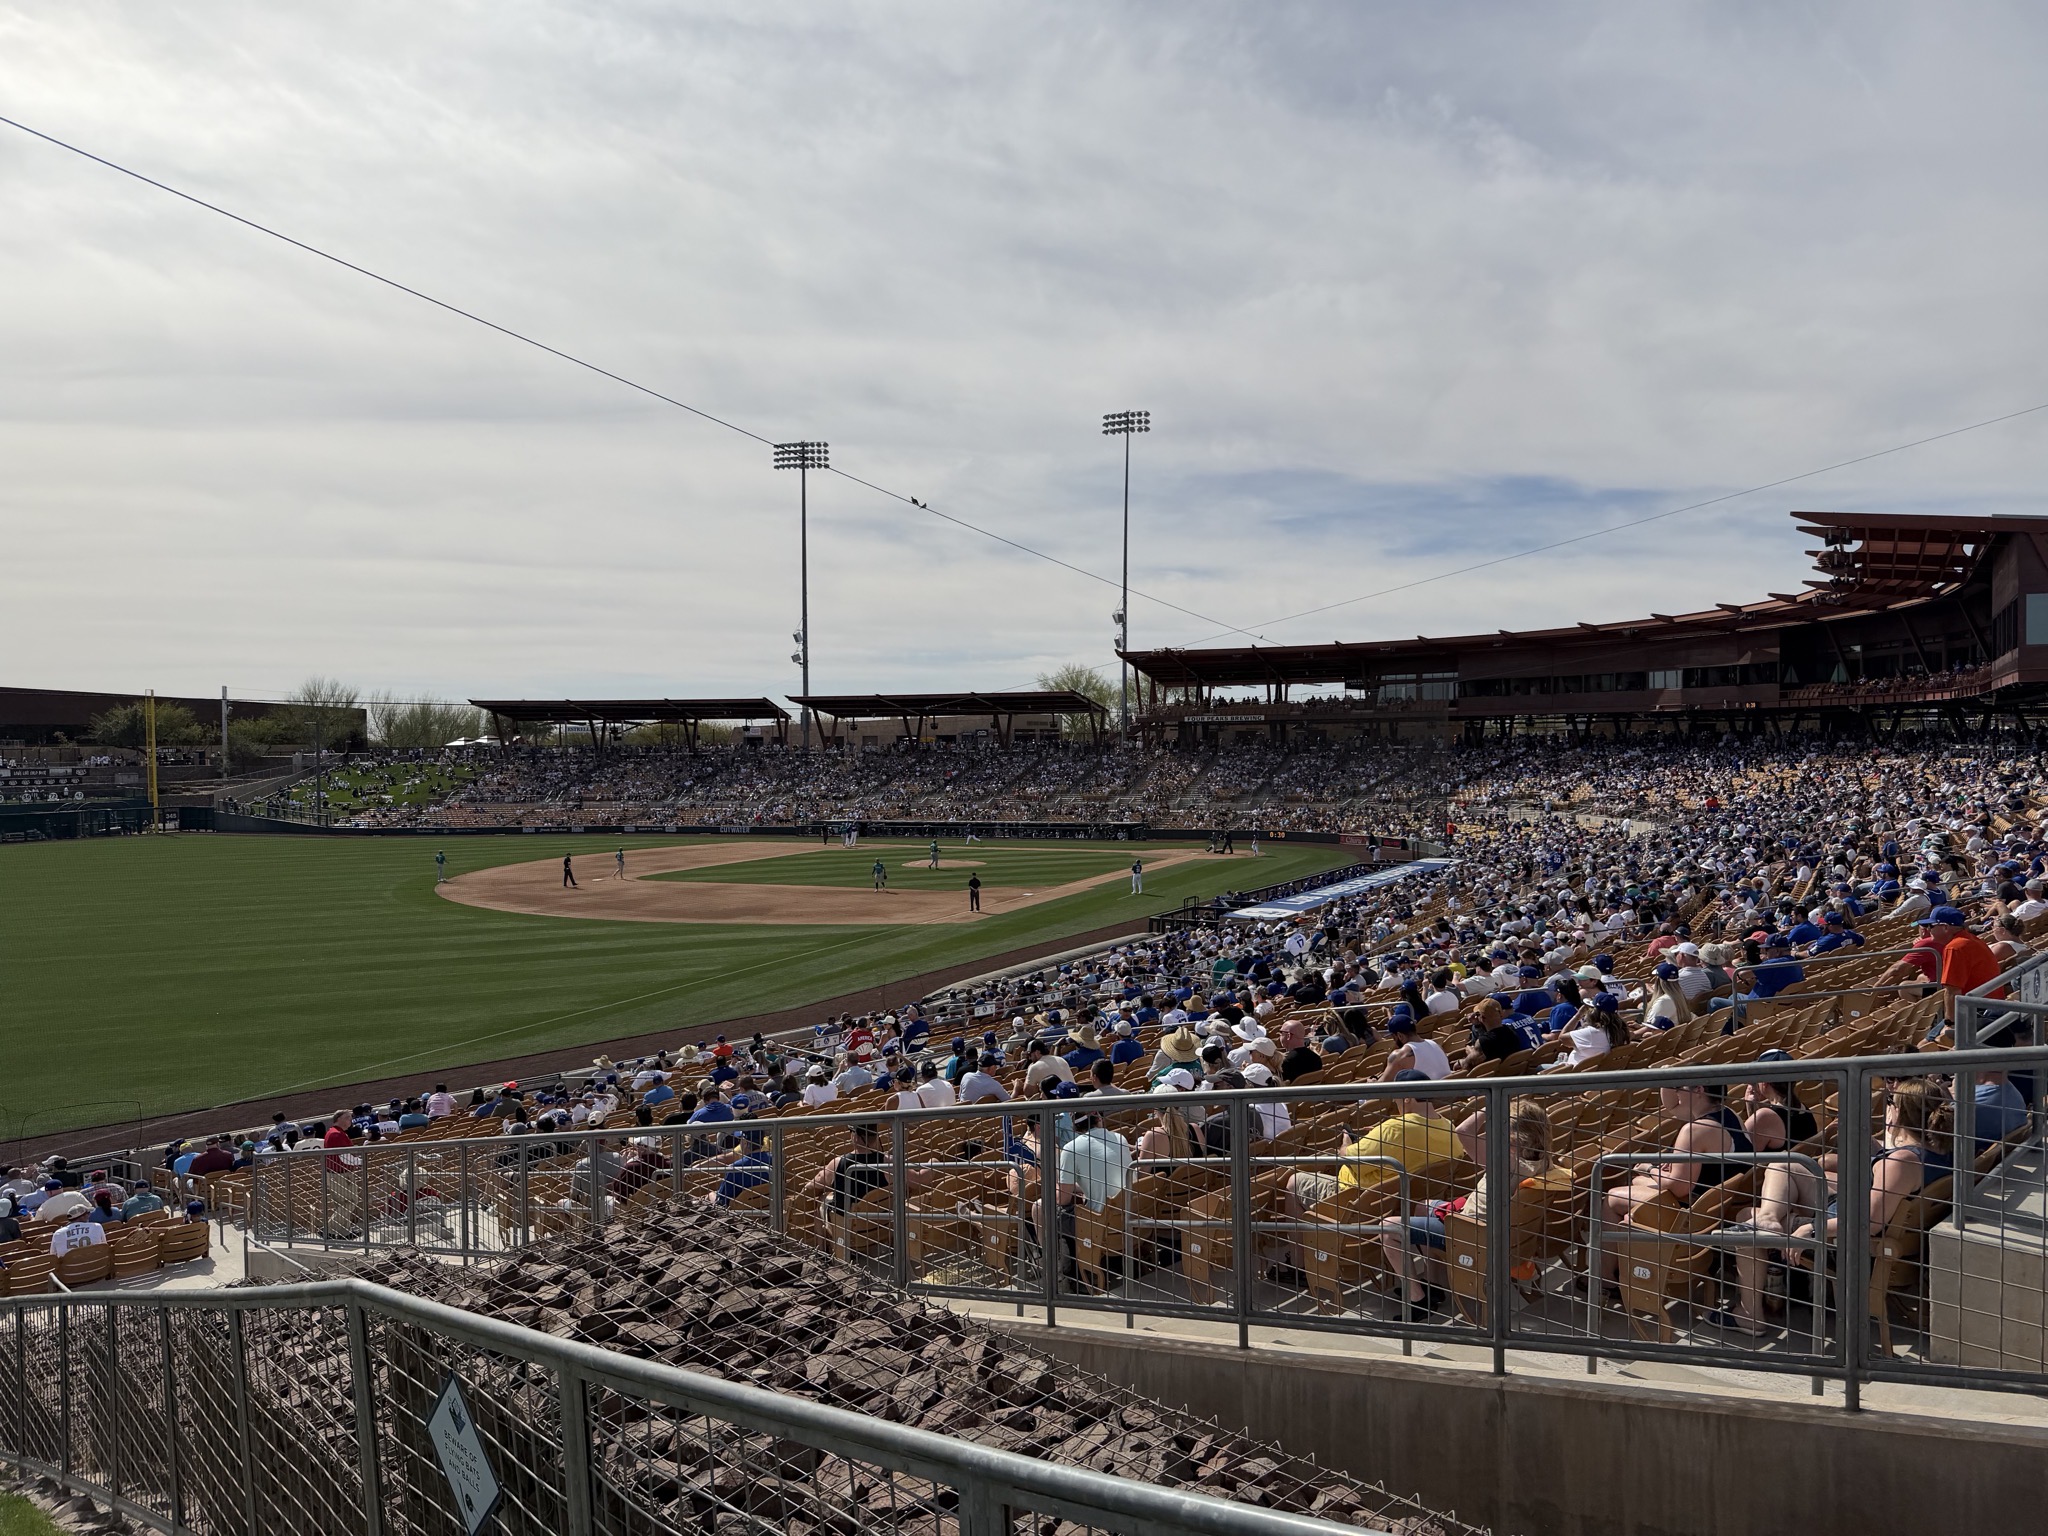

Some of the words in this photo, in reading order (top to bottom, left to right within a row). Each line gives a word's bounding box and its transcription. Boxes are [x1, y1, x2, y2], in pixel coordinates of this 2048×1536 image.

[1523, 1026, 1540, 1049] 5
[66, 1226, 90, 1238] BETTS
[66, 1236, 92, 1250] 50
[1460, 1255, 1471, 1265] 17
[1637, 1268, 1647, 1278] 18
[444, 1429, 468, 1458] BEWARE
[468, 1451, 478, 1464] OF
[444, 1442, 465, 1466] FLYING
[465, 1461, 481, 1480] BATS
[448, 1458, 461, 1475] AND
[461, 1469, 480, 1493] BALLS
